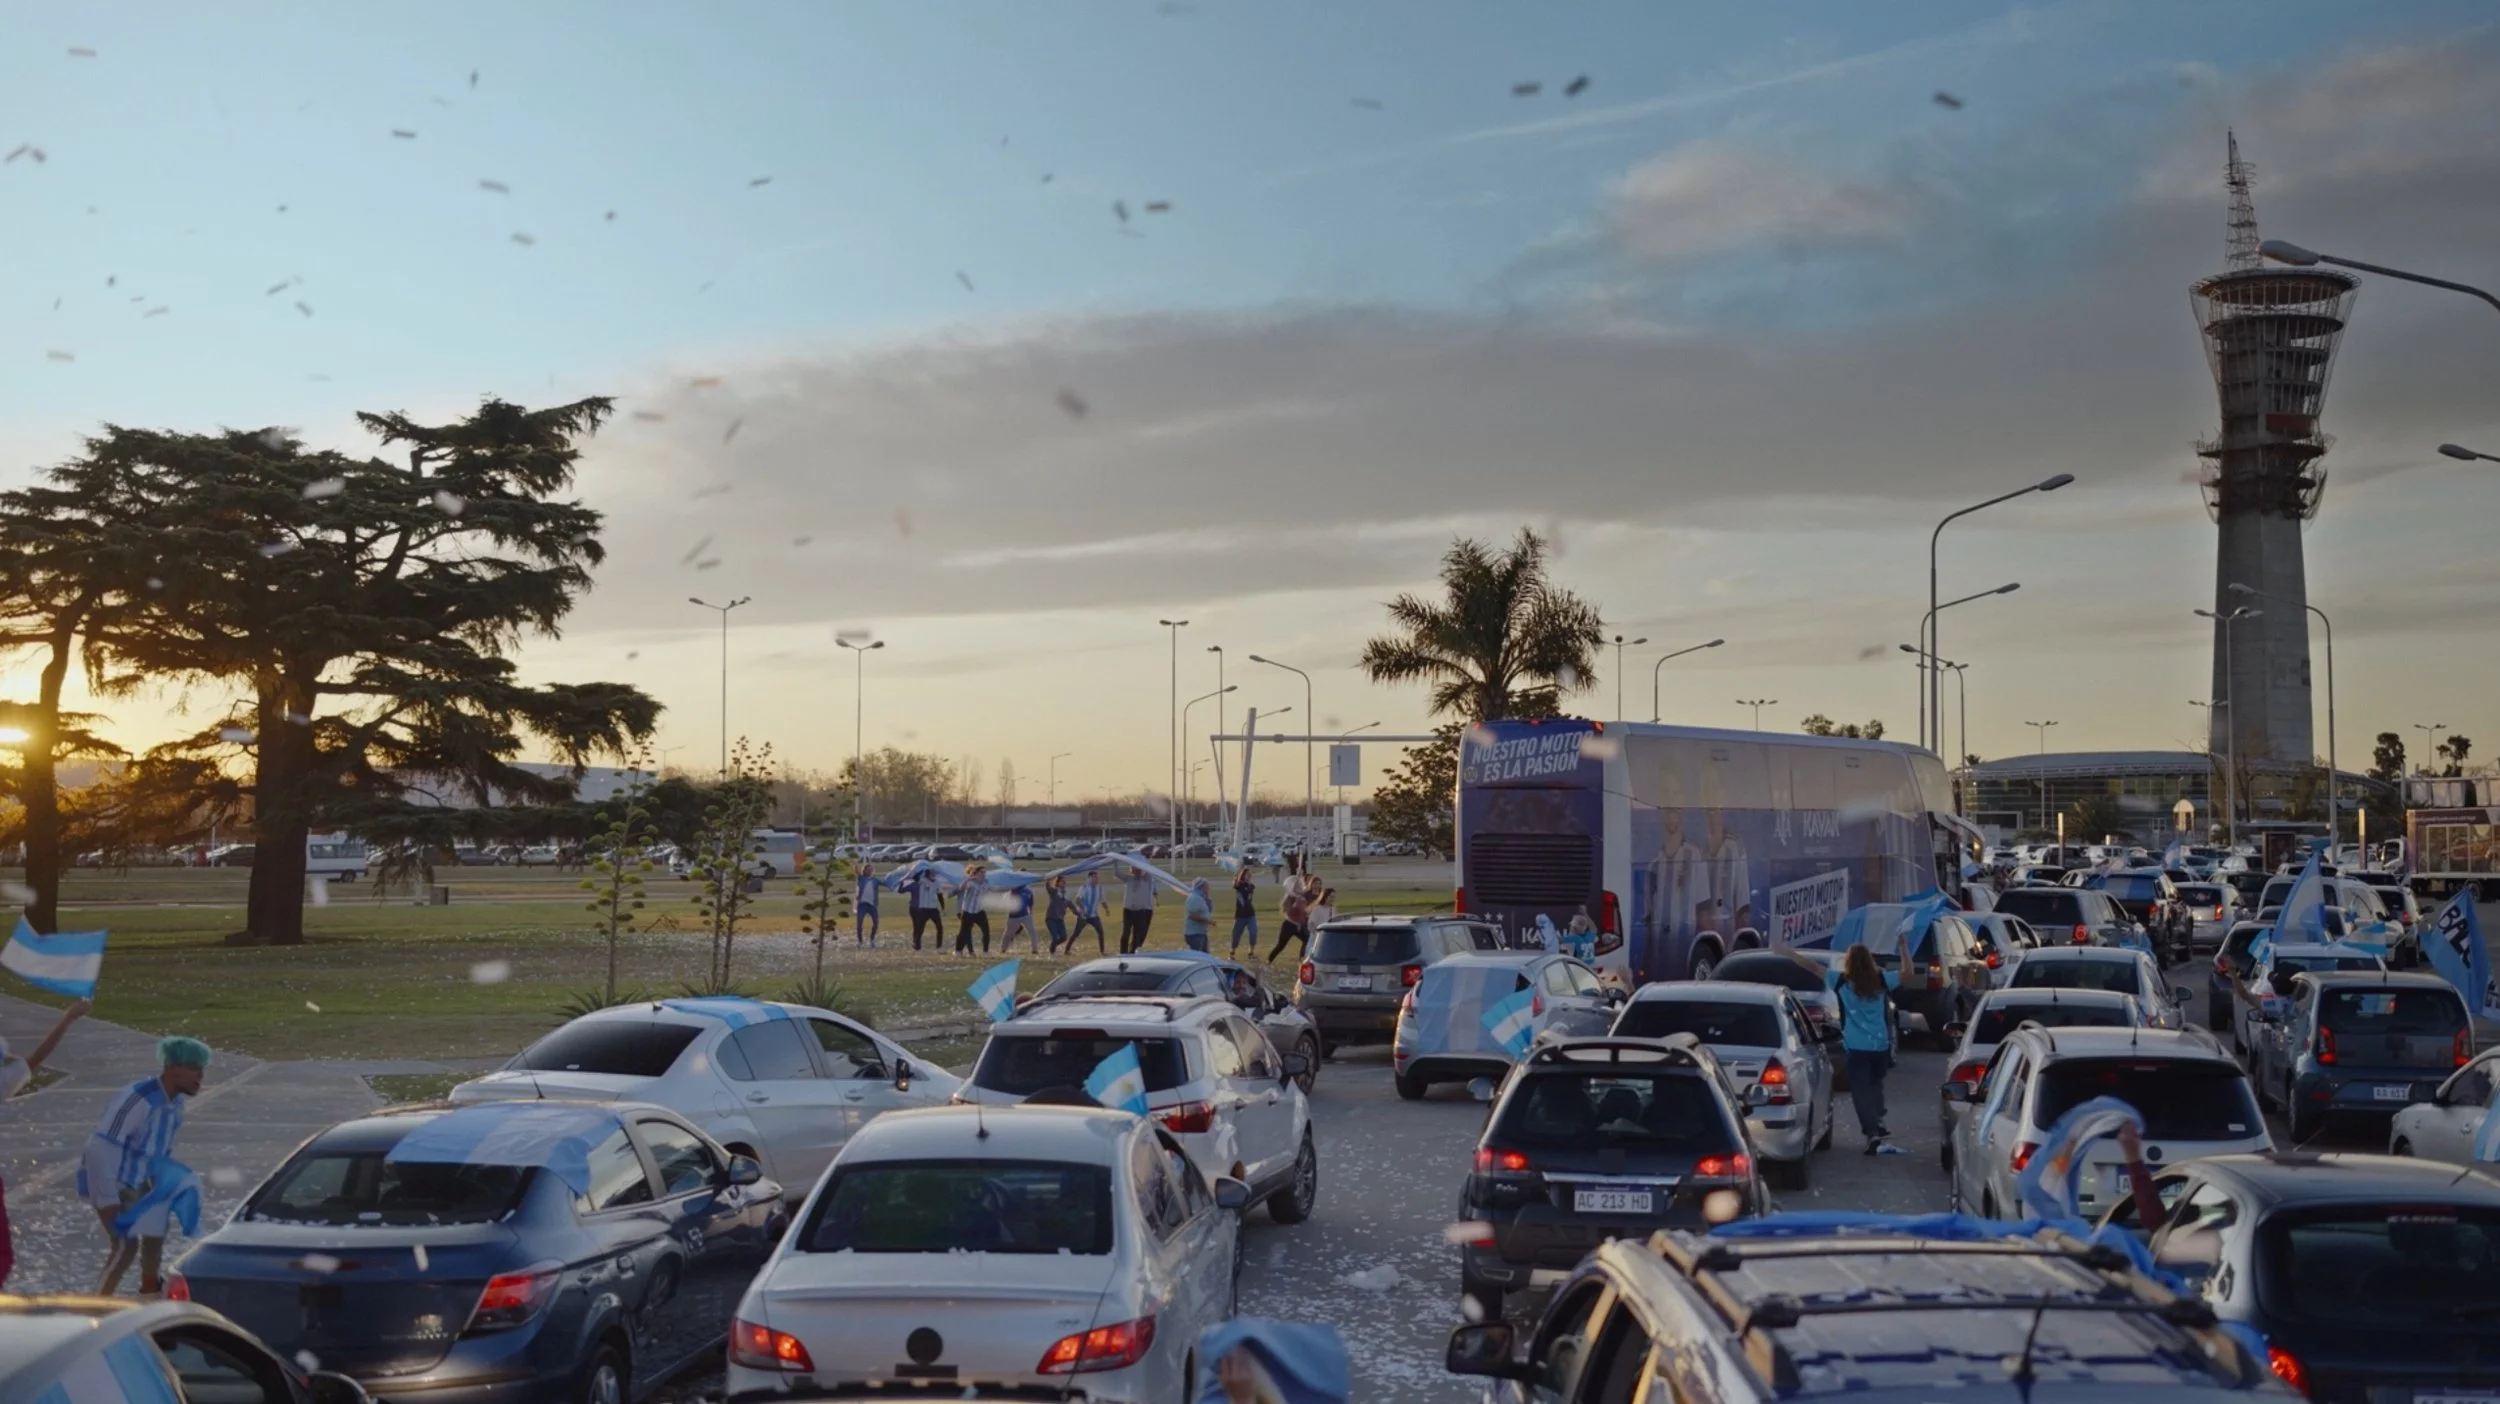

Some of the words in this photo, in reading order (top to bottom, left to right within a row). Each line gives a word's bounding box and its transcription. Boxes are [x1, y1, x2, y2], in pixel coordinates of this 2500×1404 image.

[1472, 737, 1537, 765] NUESTRO
[1483, 764, 1501, 783] ES
[1503, 760, 1521, 780] LA
[1775, 885, 1815, 916] NUESTRO
[1815, 876, 1844, 906] MOTOR
[1782, 917, 1793, 943] ES
[1793, 914, 1805, 940] LA
[1578, 1194, 1595, 1209] AC
[1601, 1193, 1626, 1209] 213
[1631, 1194, 1649, 1210] HD
